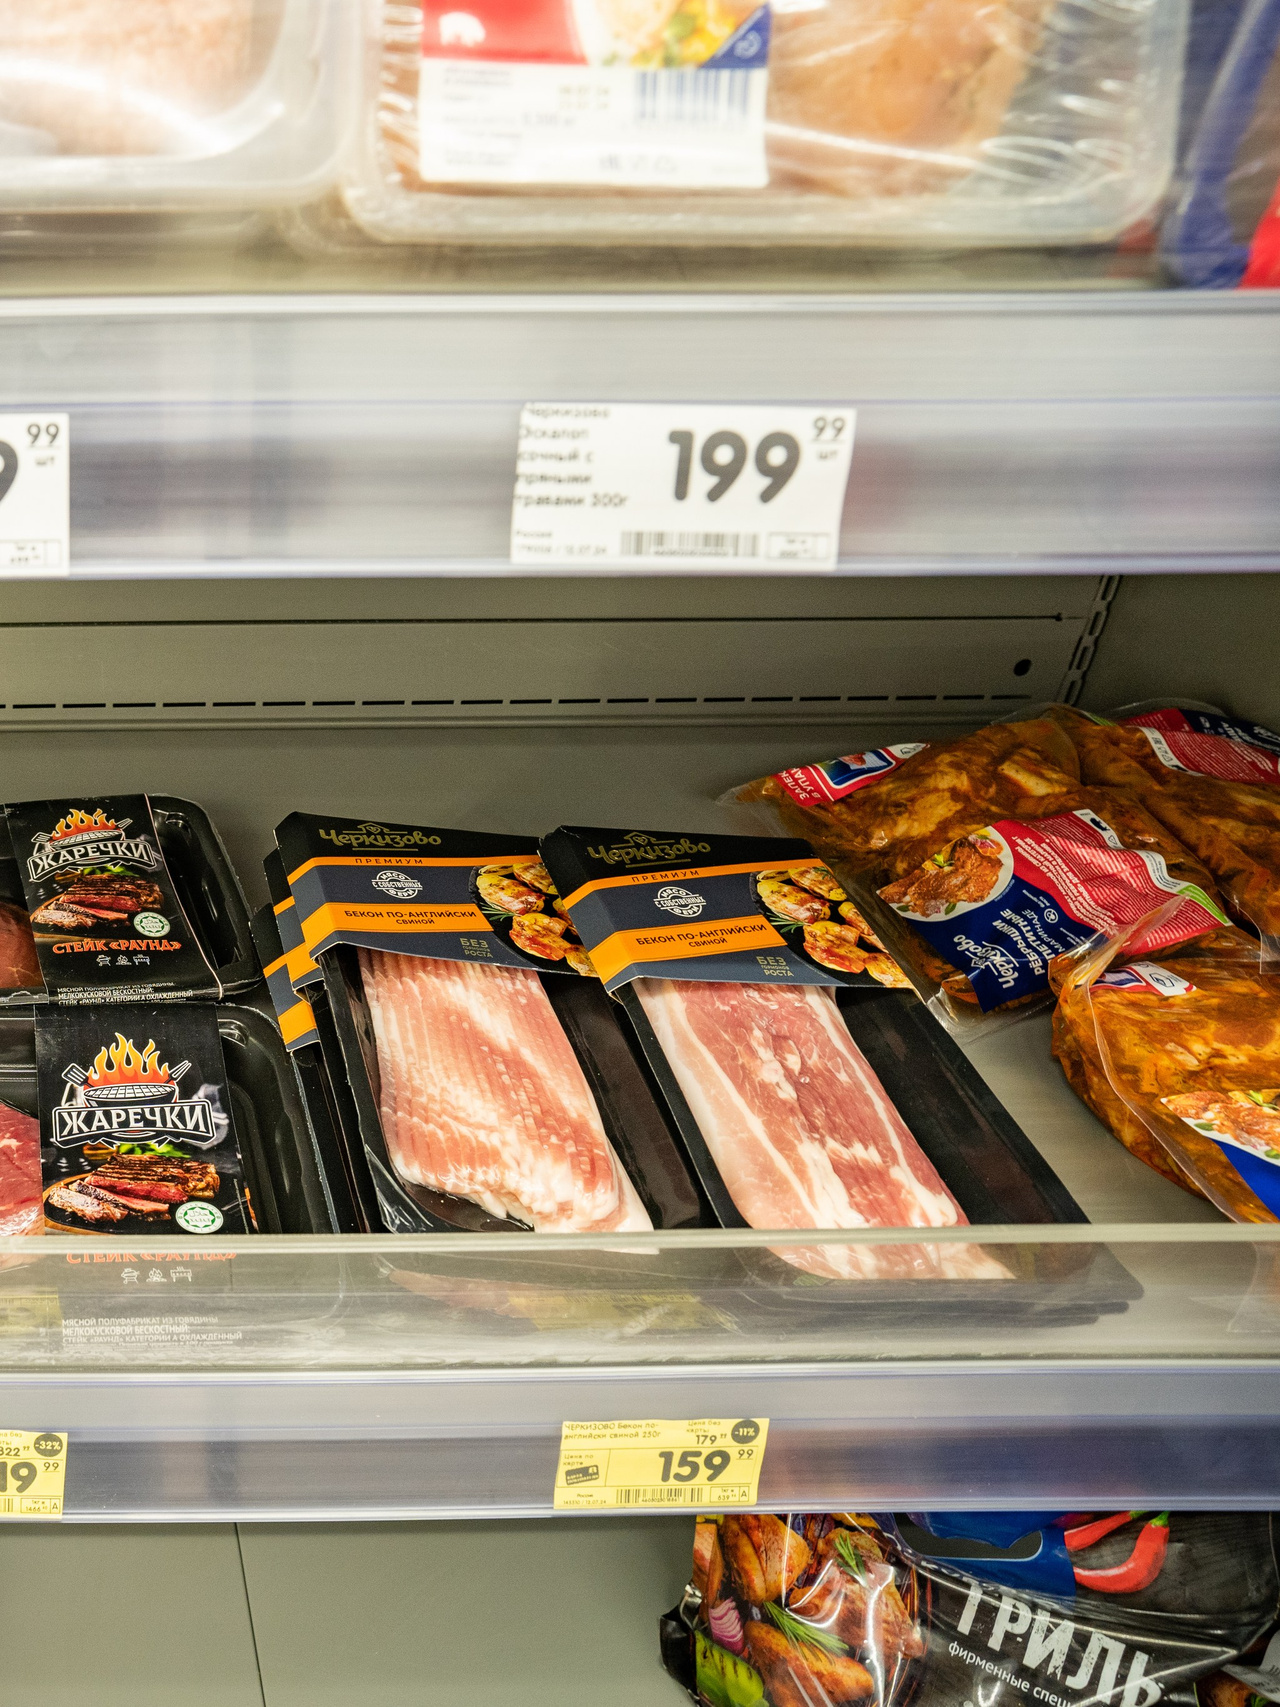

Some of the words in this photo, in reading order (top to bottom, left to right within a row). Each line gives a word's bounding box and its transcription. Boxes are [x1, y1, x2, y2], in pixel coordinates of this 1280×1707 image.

[27, 423, 59, 444] 99
[814, 417, 846, 439] 99
[669, 430, 800, 503] 199
[319, 827, 442, 847] Черкизово
[588, 838, 711, 864] Черкизово
[33, 842, 149, 874] ЖАРЕЧКИ
[355, 857, 423, 865] ПРЕМИУМ
[632, 870, 700, 882] ПРЕМИУМ
[344, 910, 384, 919] БЕКОН
[386, 908, 477, 918] ПО-АНГЛИЙСКИ
[636, 934, 675, 946] БЕКОН
[677, 924, 767, 942] ПО-АНГЛИЙСКИ
[52, 940, 109, 954] СТЕЙК
[109, 939, 182, 952] «РАУНД»
[459, 938, 488, 948] БЕЗ
[689, 937, 728, 948] СВИНОЙ
[992, 918, 1046, 976] РЁБРЫШКИ
[464, 950, 493, 958] РОСТА
[757, 955, 787, 966] БЕЗ
[953, 934, 1019, 989] Черкизово
[764, 969, 794, 978] РОСТА
[61, 1105, 206, 1136] ЖАРЕЧКИ
[63, 1317, 96, 1326] МЯСНОЙ
[98, 1317, 160, 1326] ПОЛУФАБРИКАТ
[63, 1325, 133, 1336] МЕЛКОКУСКОВОЙ
[135, 1324, 190, 1334] БЕСКОСТНЫЙ:
[179, 1331, 242, 1342] ОХЛАЖДЕННЫЙ
[565, 1422, 616, 1431] ЧЕРКИЗОВО
[735, 1428, 755, 1437] -11%
[35, 1441, 61, 1450] -32%
[696, 1435, 717, 1445] 179
[738, 1449, 754, 1459] 99
[43, 1462, 60, 1471] 99
[658, 1449, 731, 1483] 159
[948, 1641, 1030, 1692] фирменные
